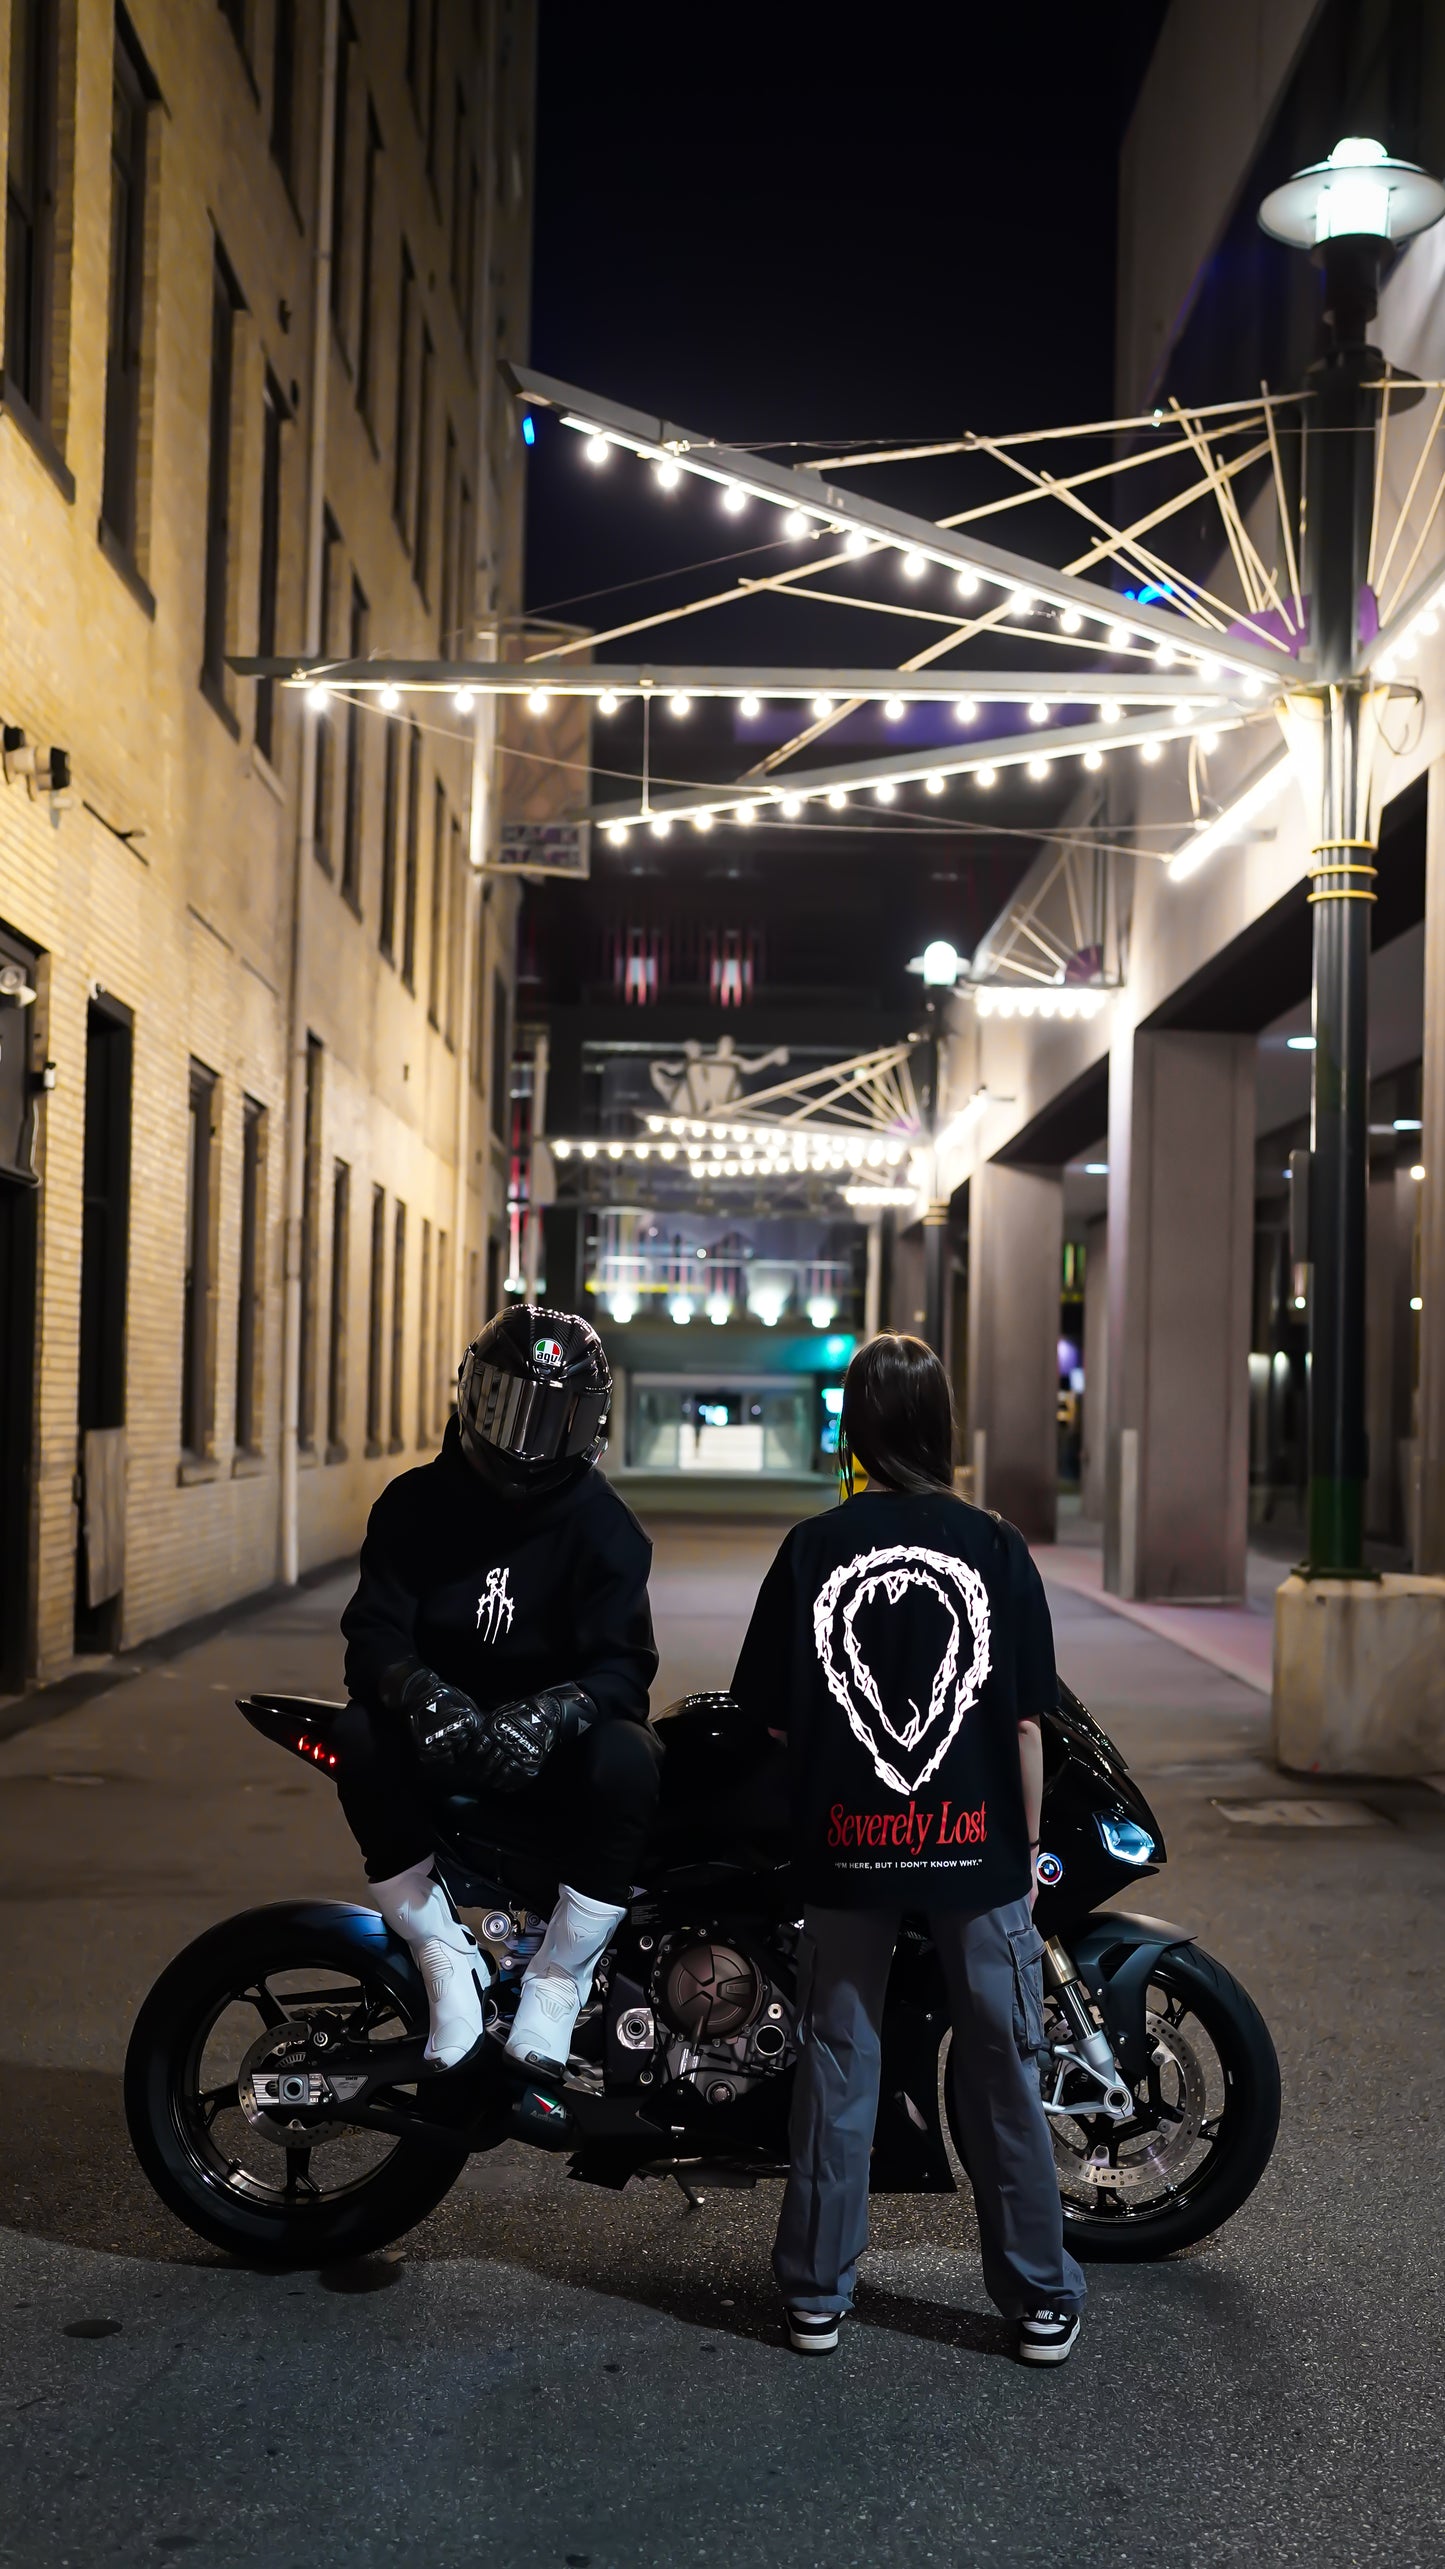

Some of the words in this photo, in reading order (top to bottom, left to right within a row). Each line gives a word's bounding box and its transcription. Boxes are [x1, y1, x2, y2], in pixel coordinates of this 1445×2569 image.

[536, 1351, 558, 1364] agv
[827, 1800, 934, 1855] Severely
[936, 1800, 988, 1845] Lost
[849, 1862, 873, 1870] HERE,
[875, 1861, 893, 1869] BUT
[895, 1861, 898, 1869] I
[900, 1860, 928, 1869] DON'T
[930, 1859, 957, 1868] KNOW
[1035, 2309, 1054, 2320] NIKE
